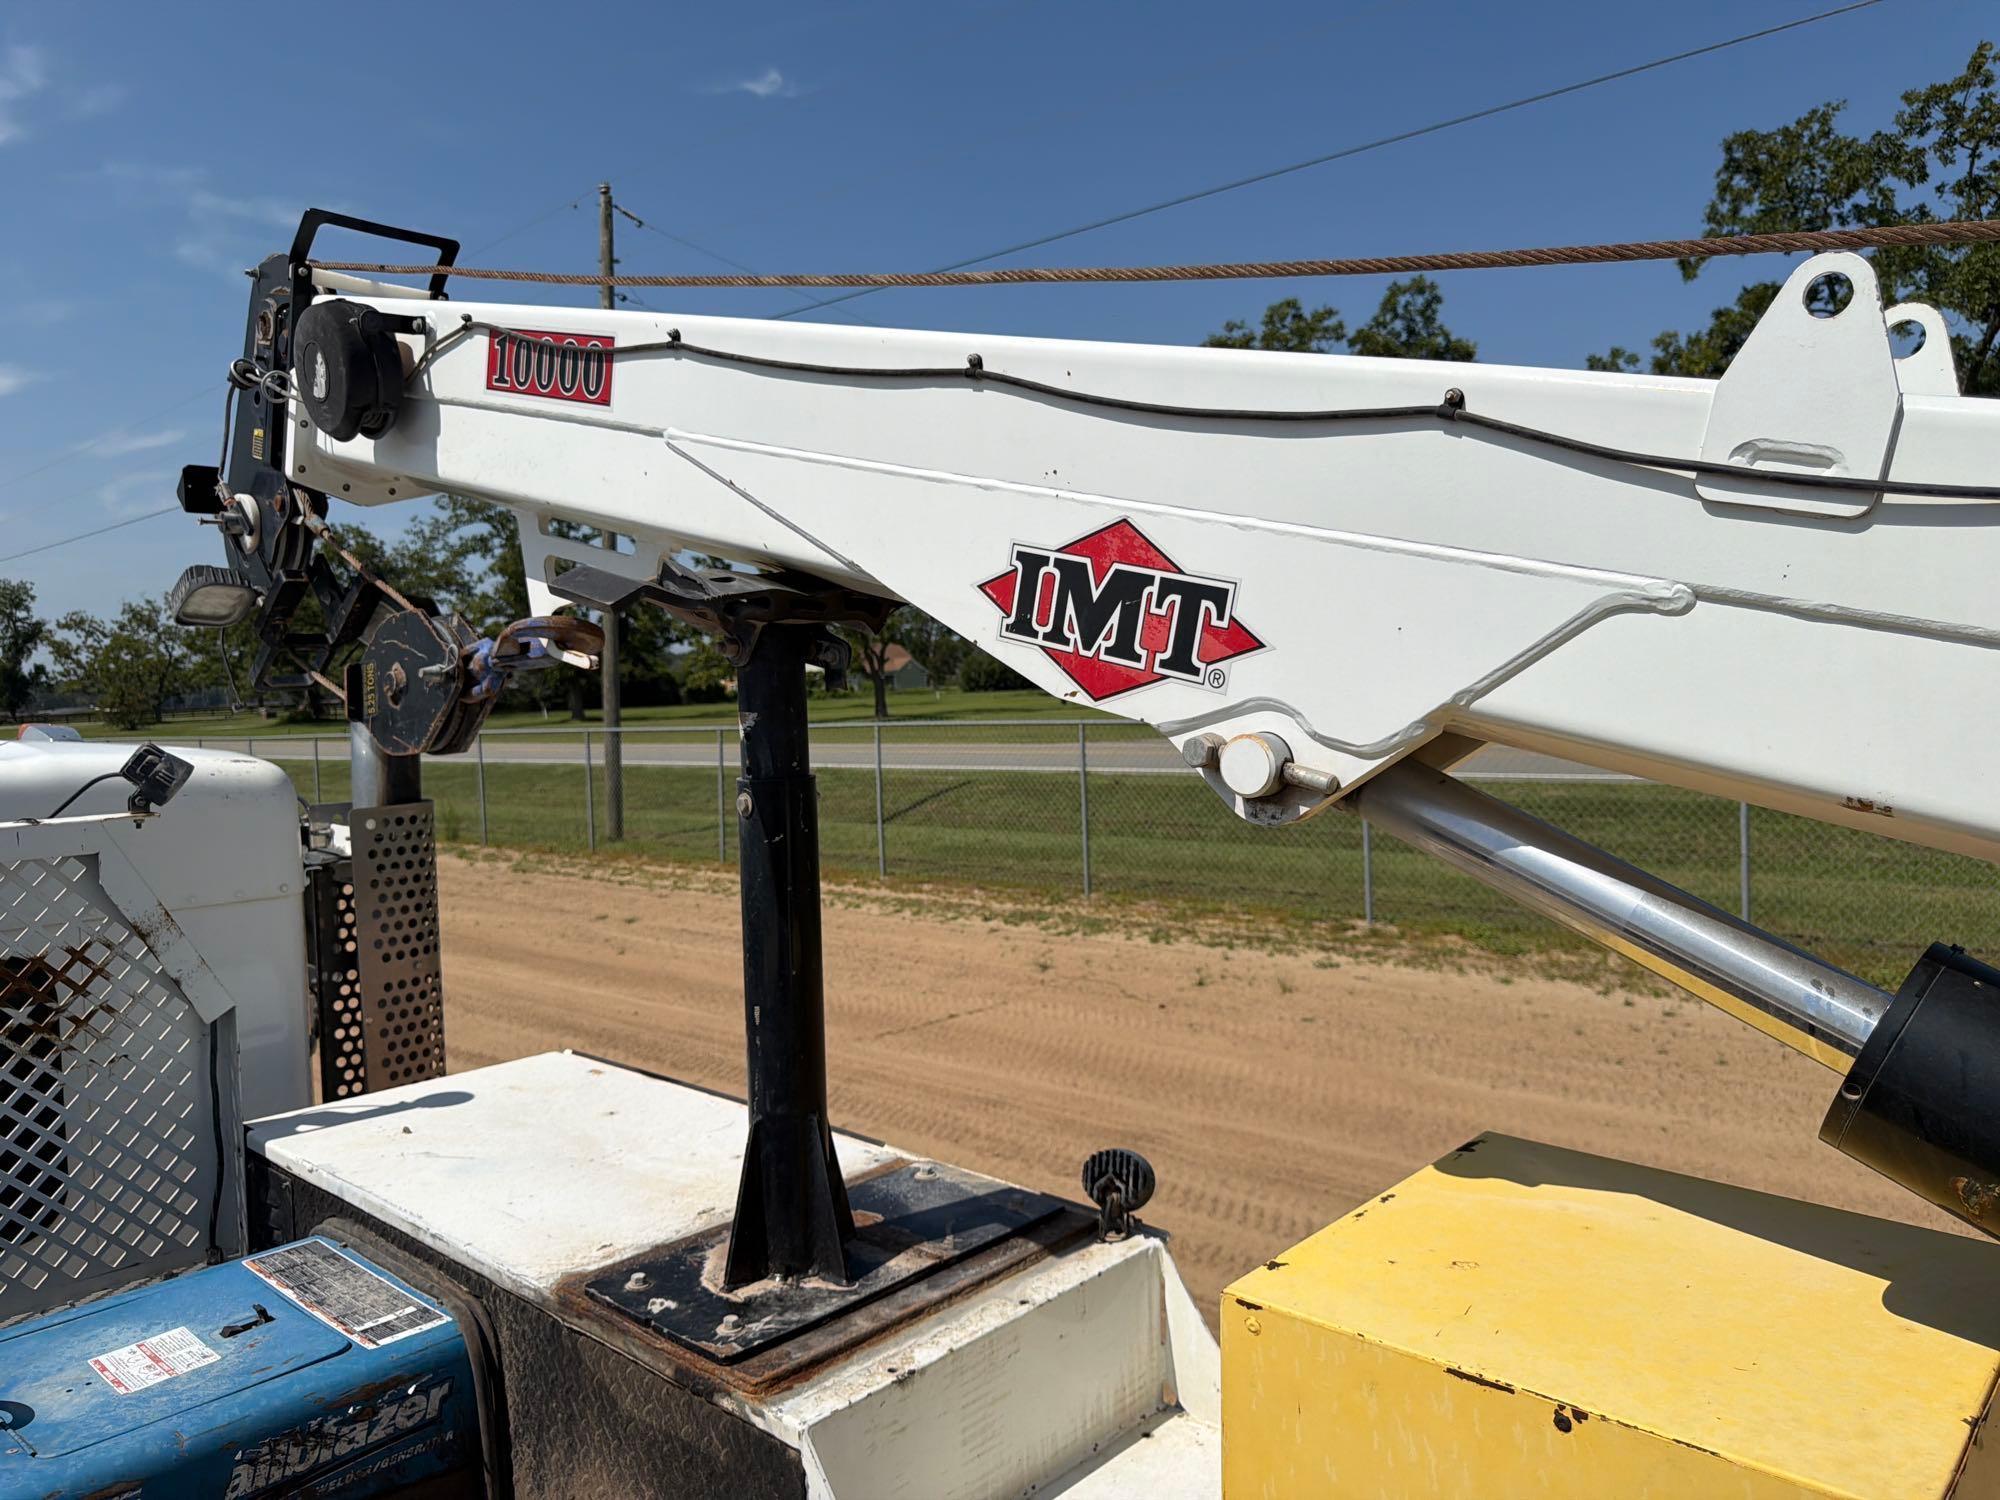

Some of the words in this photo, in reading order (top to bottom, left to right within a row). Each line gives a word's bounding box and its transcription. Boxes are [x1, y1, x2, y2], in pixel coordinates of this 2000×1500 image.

[492, 334, 606, 400] 10000
[1002, 545, 1235, 682] IMT
[366, 663, 375, 691] TONS
